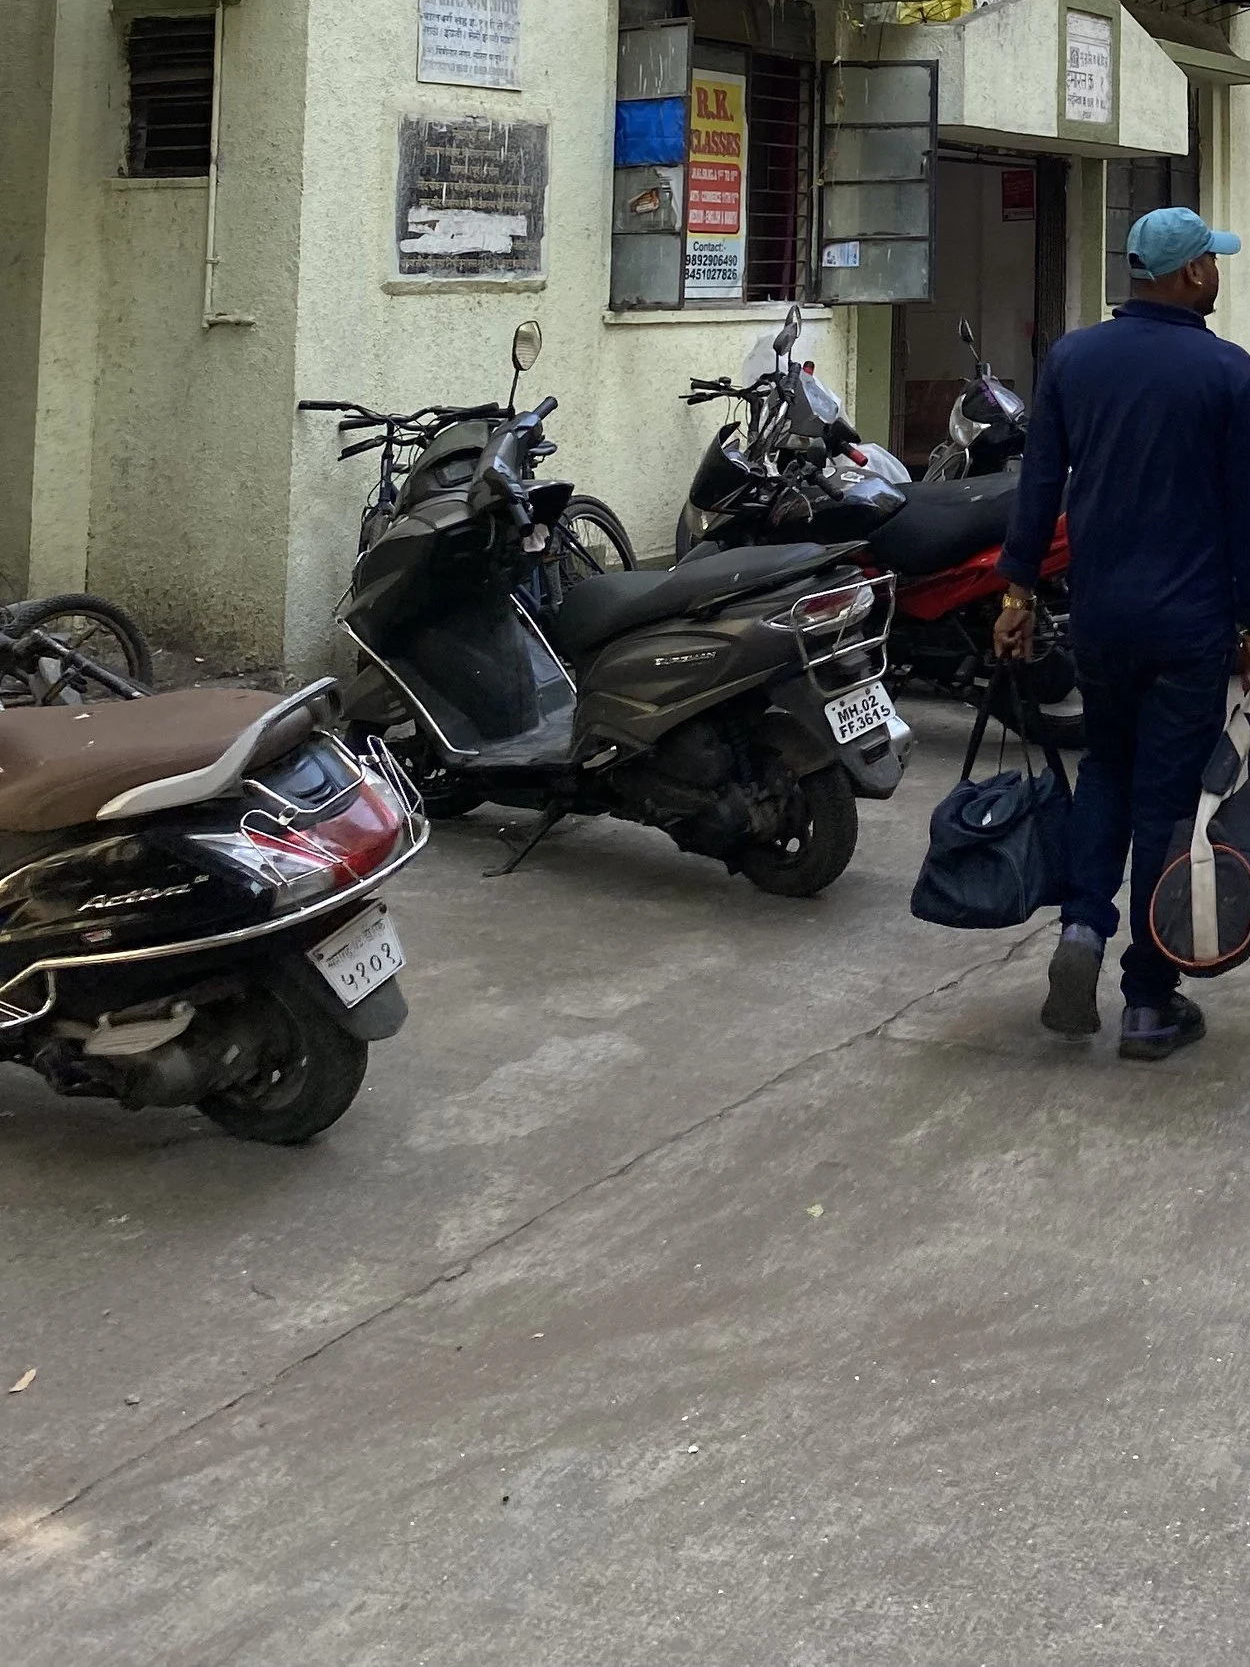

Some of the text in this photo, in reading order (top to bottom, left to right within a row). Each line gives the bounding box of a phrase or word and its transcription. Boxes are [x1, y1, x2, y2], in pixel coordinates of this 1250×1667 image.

[696, 86, 734, 122] R.K.
[690, 129, 741, 158] CLASSES
[685, 254, 738, 266] 9892906490
[837, 695, 879, 725] MH.02
[838, 704, 891, 739] FF.3615
